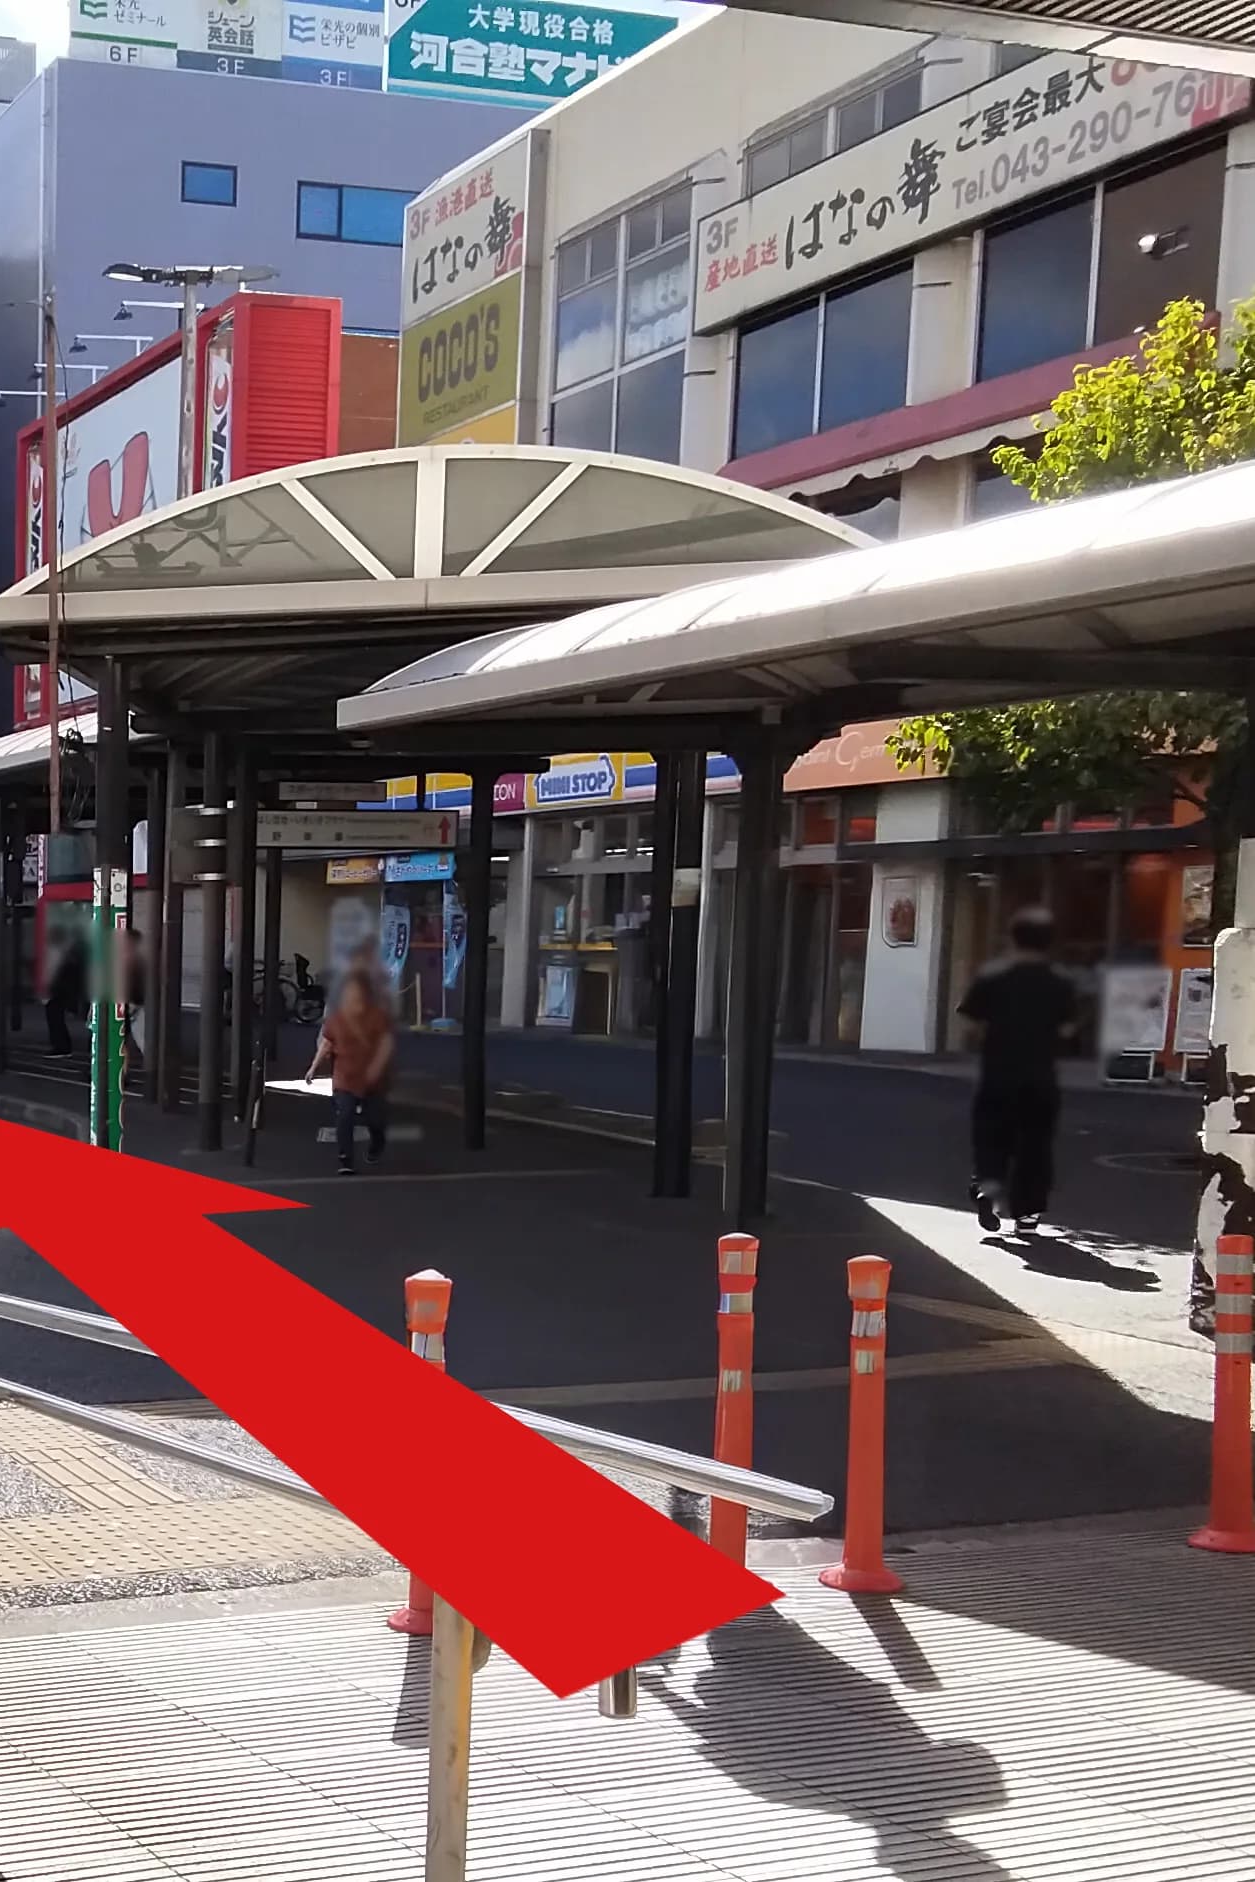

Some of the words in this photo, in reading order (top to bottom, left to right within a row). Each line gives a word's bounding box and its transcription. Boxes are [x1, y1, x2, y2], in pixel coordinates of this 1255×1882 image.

[114, 10, 166, 27] ゼミナール
[321, 19, 381, 38] 栄光の個別
[468, 3, 614, 46] 大学現役合格
[207, 26, 254, 46] 英会話
[321, 34, 356, 50] ビザビ
[109, 46, 138, 63] 6F
[217, 57, 245, 73] 3F
[319, 69, 347, 86] 3F
[786, 138, 946, 271] はなの舞
[410, 207, 431, 240] 3F
[706, 217, 739, 255] 3F
[412, 195, 515, 304] はなの舞
[705, 234, 779, 292] 産地直送
[418, 303, 500, 402] COCO'S
[423, 385, 490, 425] RESTAURANT
[541, 774, 571, 798] MINI
[572, 770, 608, 794] STOP
